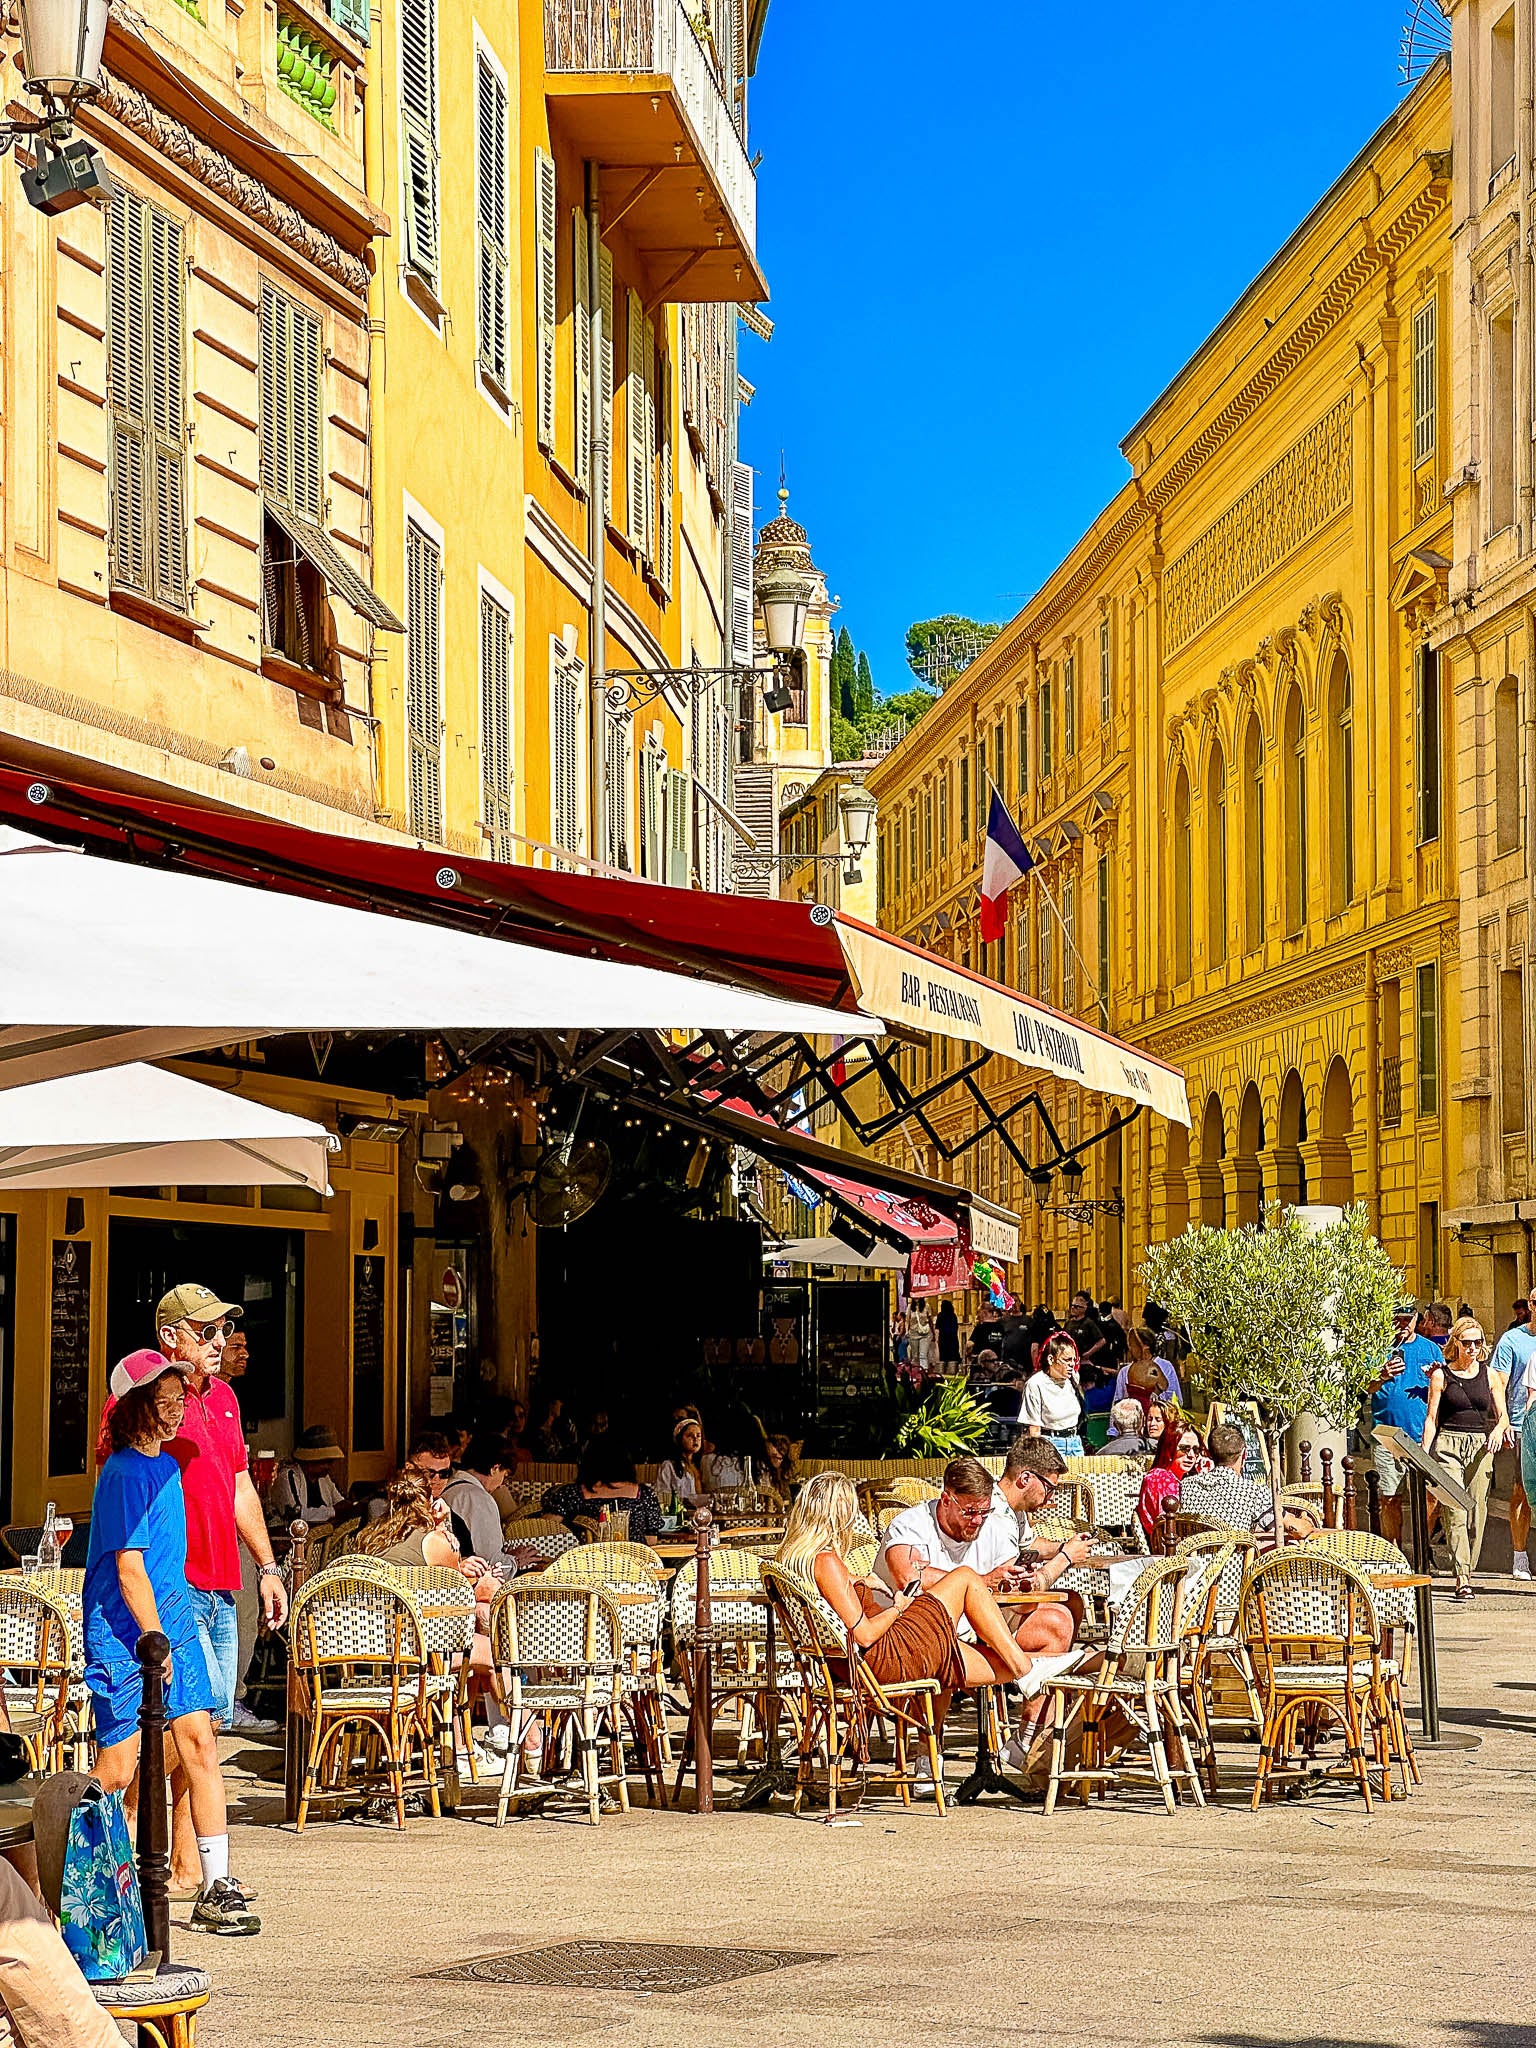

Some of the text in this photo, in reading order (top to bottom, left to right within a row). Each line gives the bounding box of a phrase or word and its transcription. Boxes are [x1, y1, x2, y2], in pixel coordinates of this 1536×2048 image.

[901, 971, 921, 1008] BAR
[927, 981, 982, 1028] RESTAURANT
[1012, 1011, 1036, 1055] LOU
